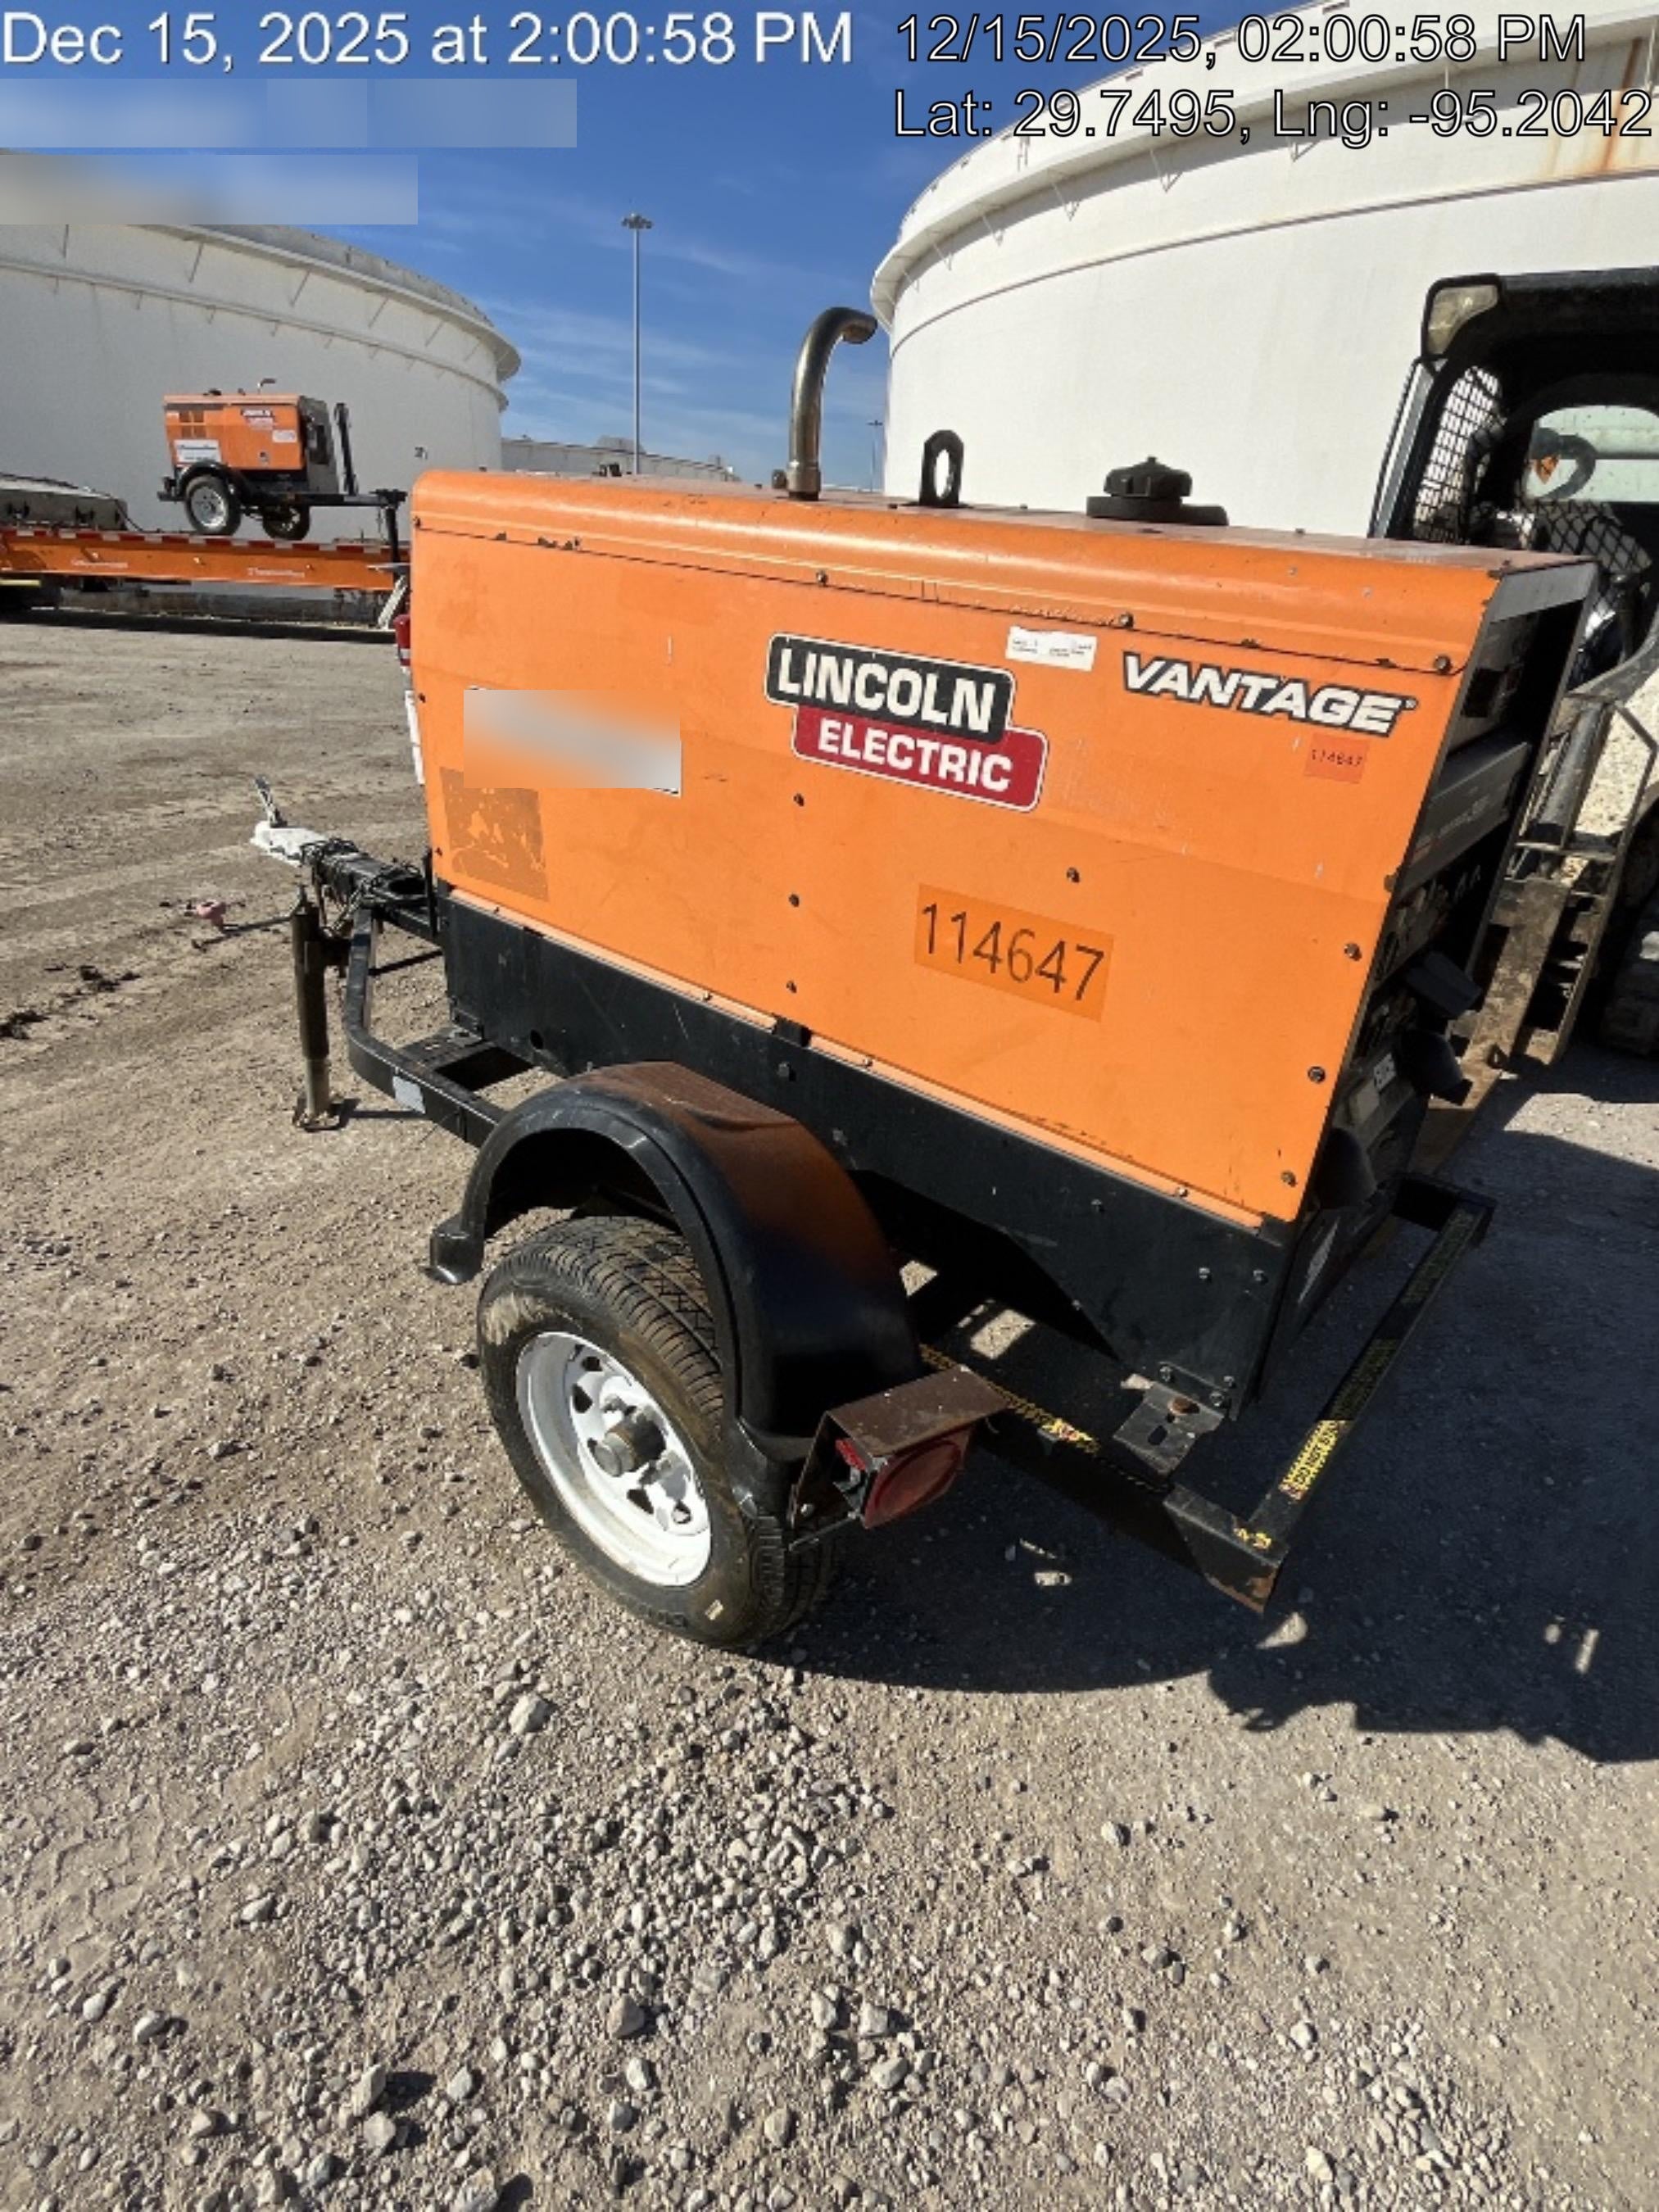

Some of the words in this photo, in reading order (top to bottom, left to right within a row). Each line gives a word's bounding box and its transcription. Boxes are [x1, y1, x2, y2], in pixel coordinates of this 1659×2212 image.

[777, 647, 996, 734] LINCOLN
[1124, 653, 1403, 737] VANTAGE
[817, 717, 1014, 792] ELECTRIC
[922, 903, 1105, 1001] 114647
